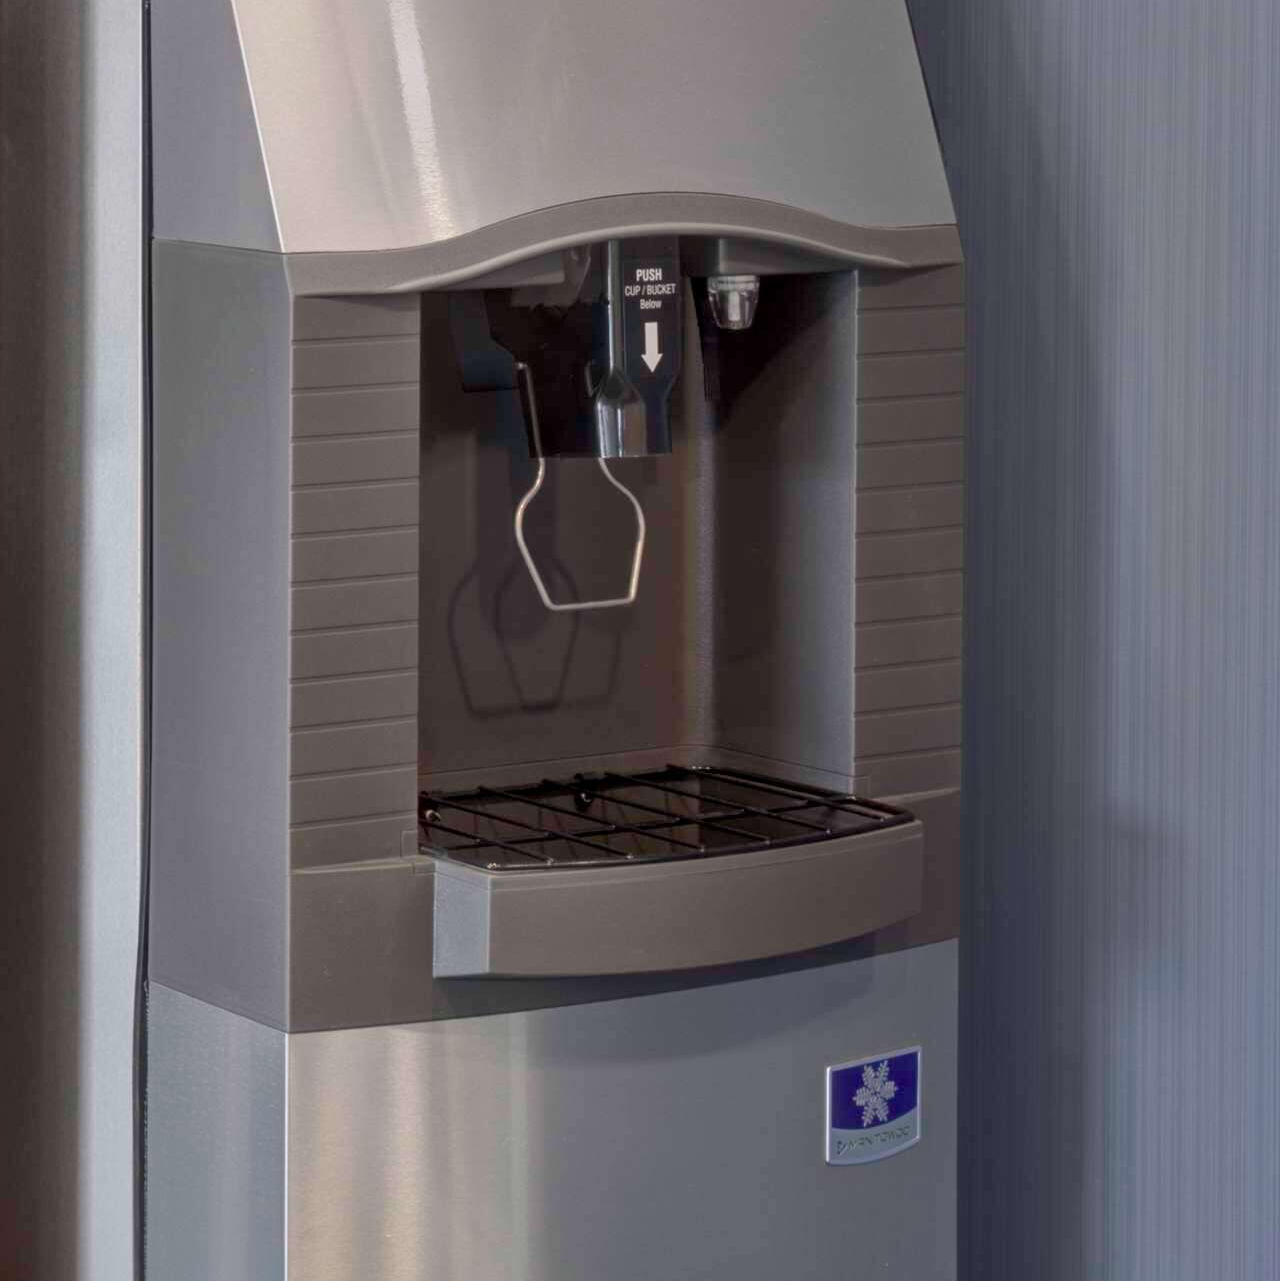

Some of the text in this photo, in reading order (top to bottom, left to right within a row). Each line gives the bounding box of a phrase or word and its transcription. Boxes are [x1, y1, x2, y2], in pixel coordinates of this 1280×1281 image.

[636, 268, 662, 282] PUSH
[624, 285, 641, 297] CUP
[646, 283, 677, 296] BUCKET
[639, 298, 662, 310] Below
